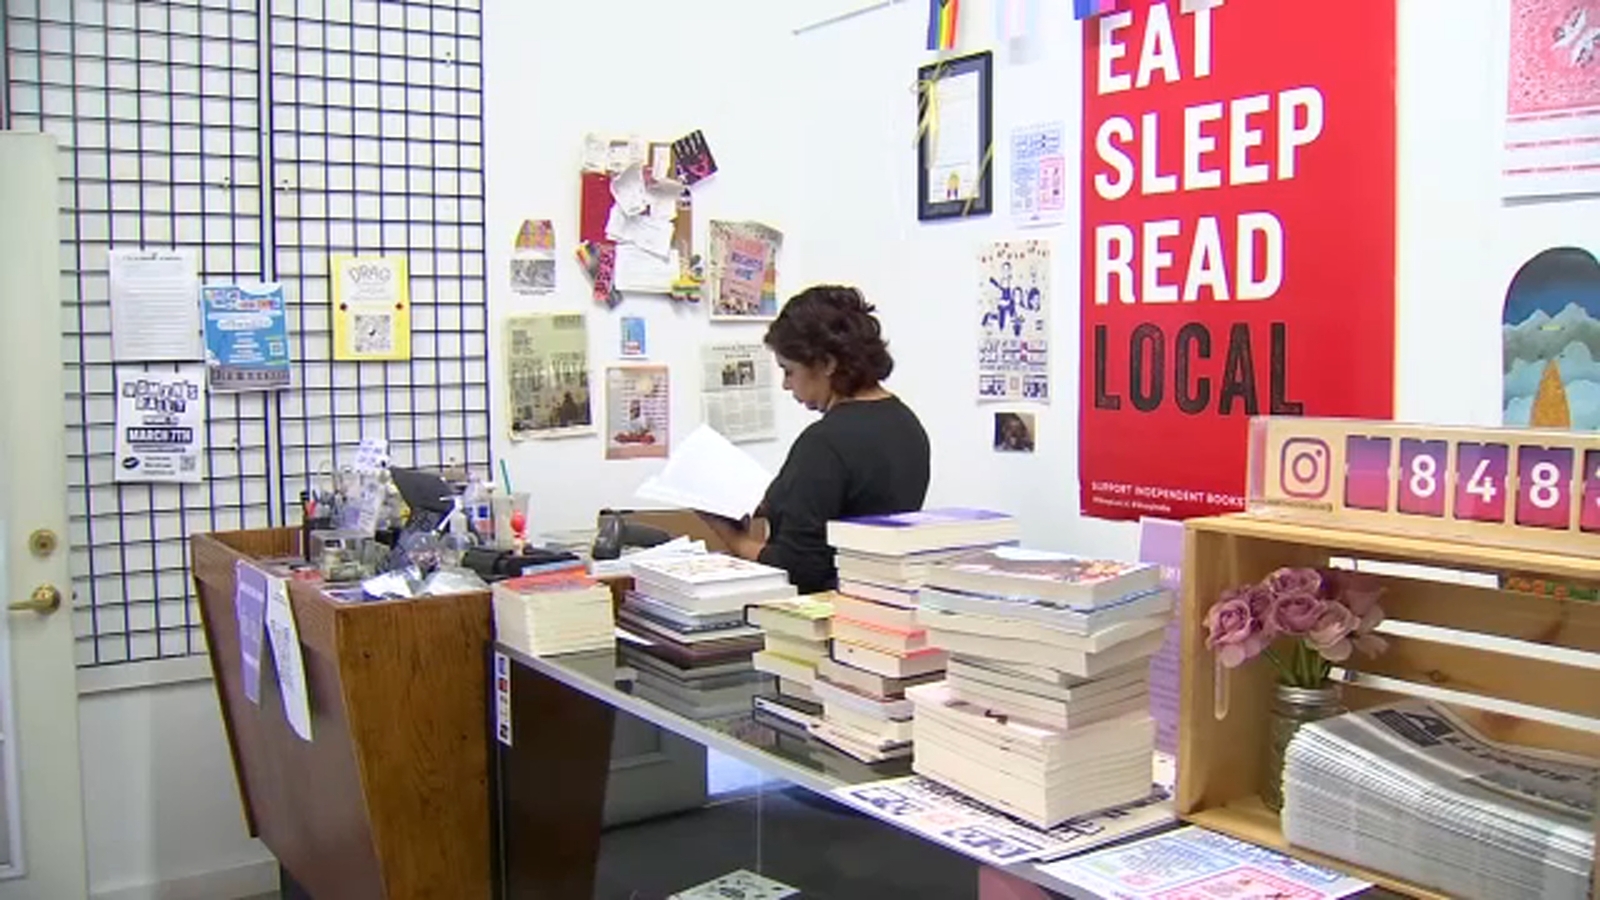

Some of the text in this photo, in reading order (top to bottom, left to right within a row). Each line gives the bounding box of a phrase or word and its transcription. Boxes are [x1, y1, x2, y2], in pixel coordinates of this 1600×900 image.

[1098, 2, 1212, 95] EAT
[1094, 86, 1324, 200] SLEEP
[349, 264, 391, 283] DRAG
[1095, 212, 1283, 304] READ
[1094, 322, 1303, 415] LOCAL
[128, 428, 192, 442] MARCH 7TH
[1092, 481, 1132, 495] SUPPORT
[1135, 487, 1204, 503] INDEPENDENT
[1206, 494, 1245, 508] BOOKS
